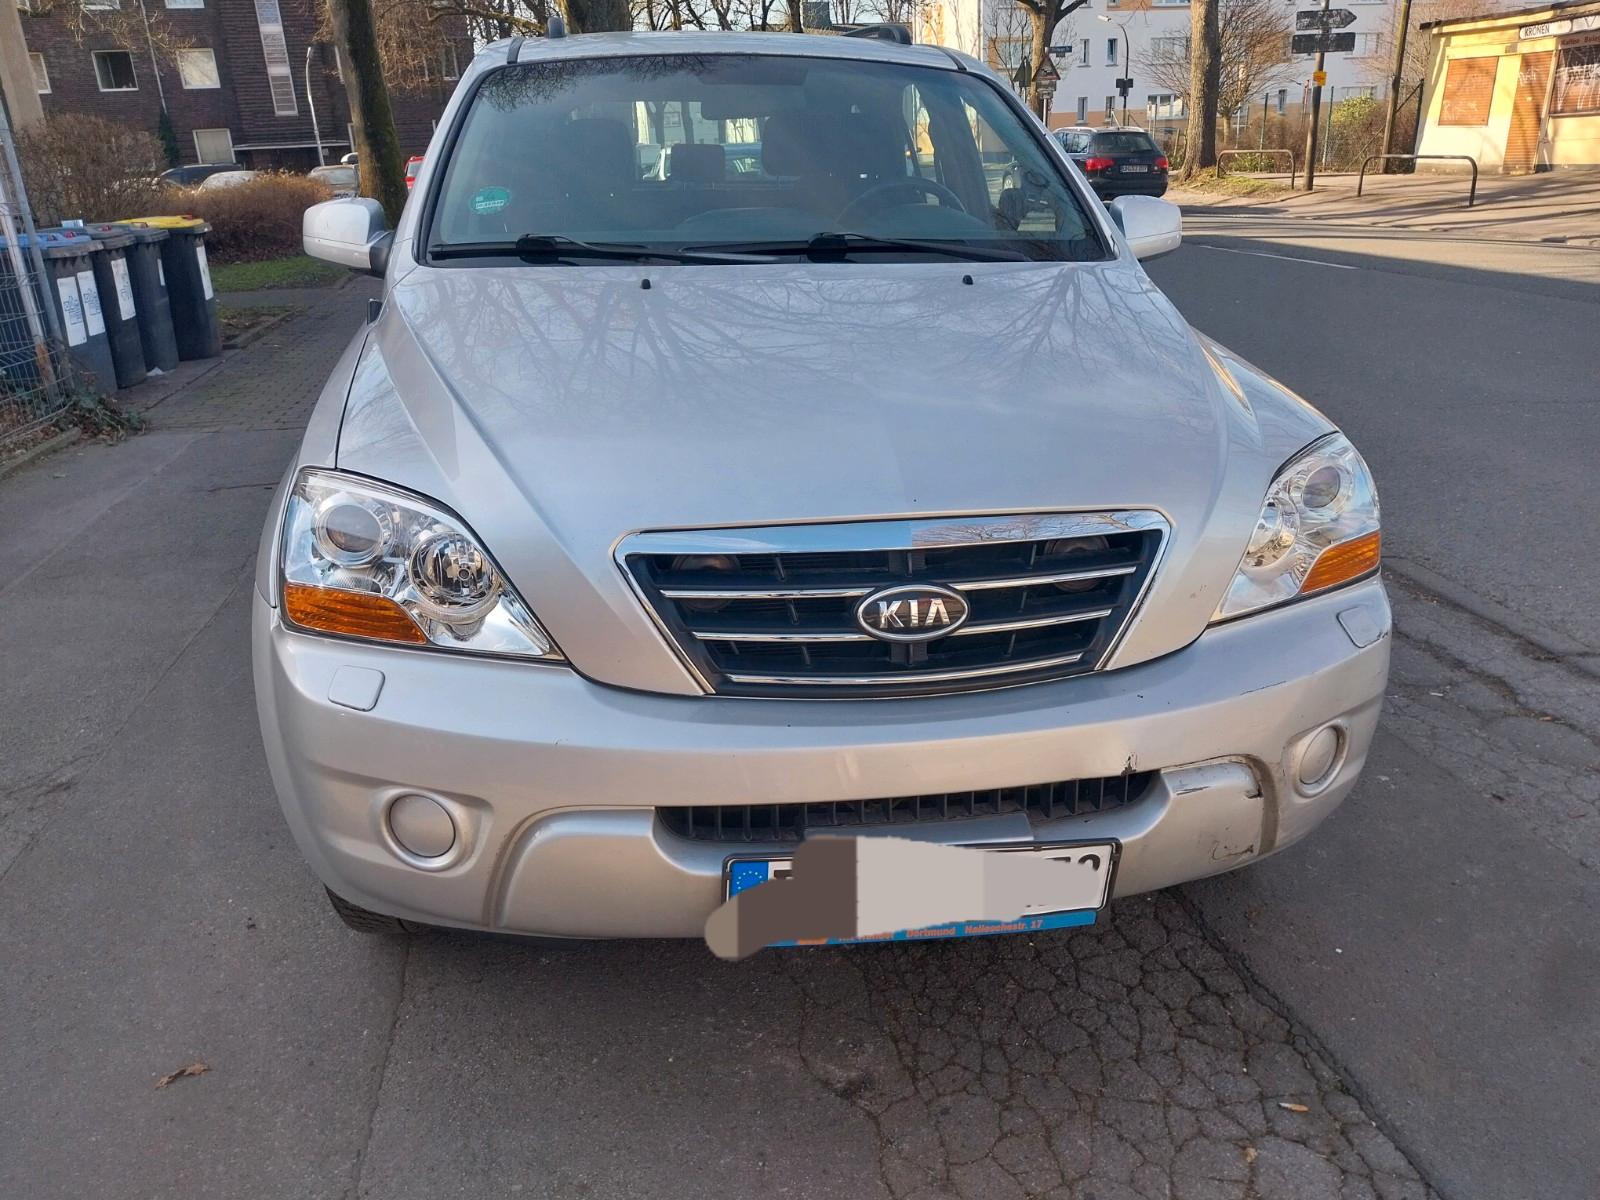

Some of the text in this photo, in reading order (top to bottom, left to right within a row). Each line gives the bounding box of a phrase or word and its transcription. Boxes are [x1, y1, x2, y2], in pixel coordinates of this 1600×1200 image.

[1524, 24, 1550, 37] KRONEN
[877, 598, 951, 629] KIA
[906, 926, 956, 938] Dortmund
